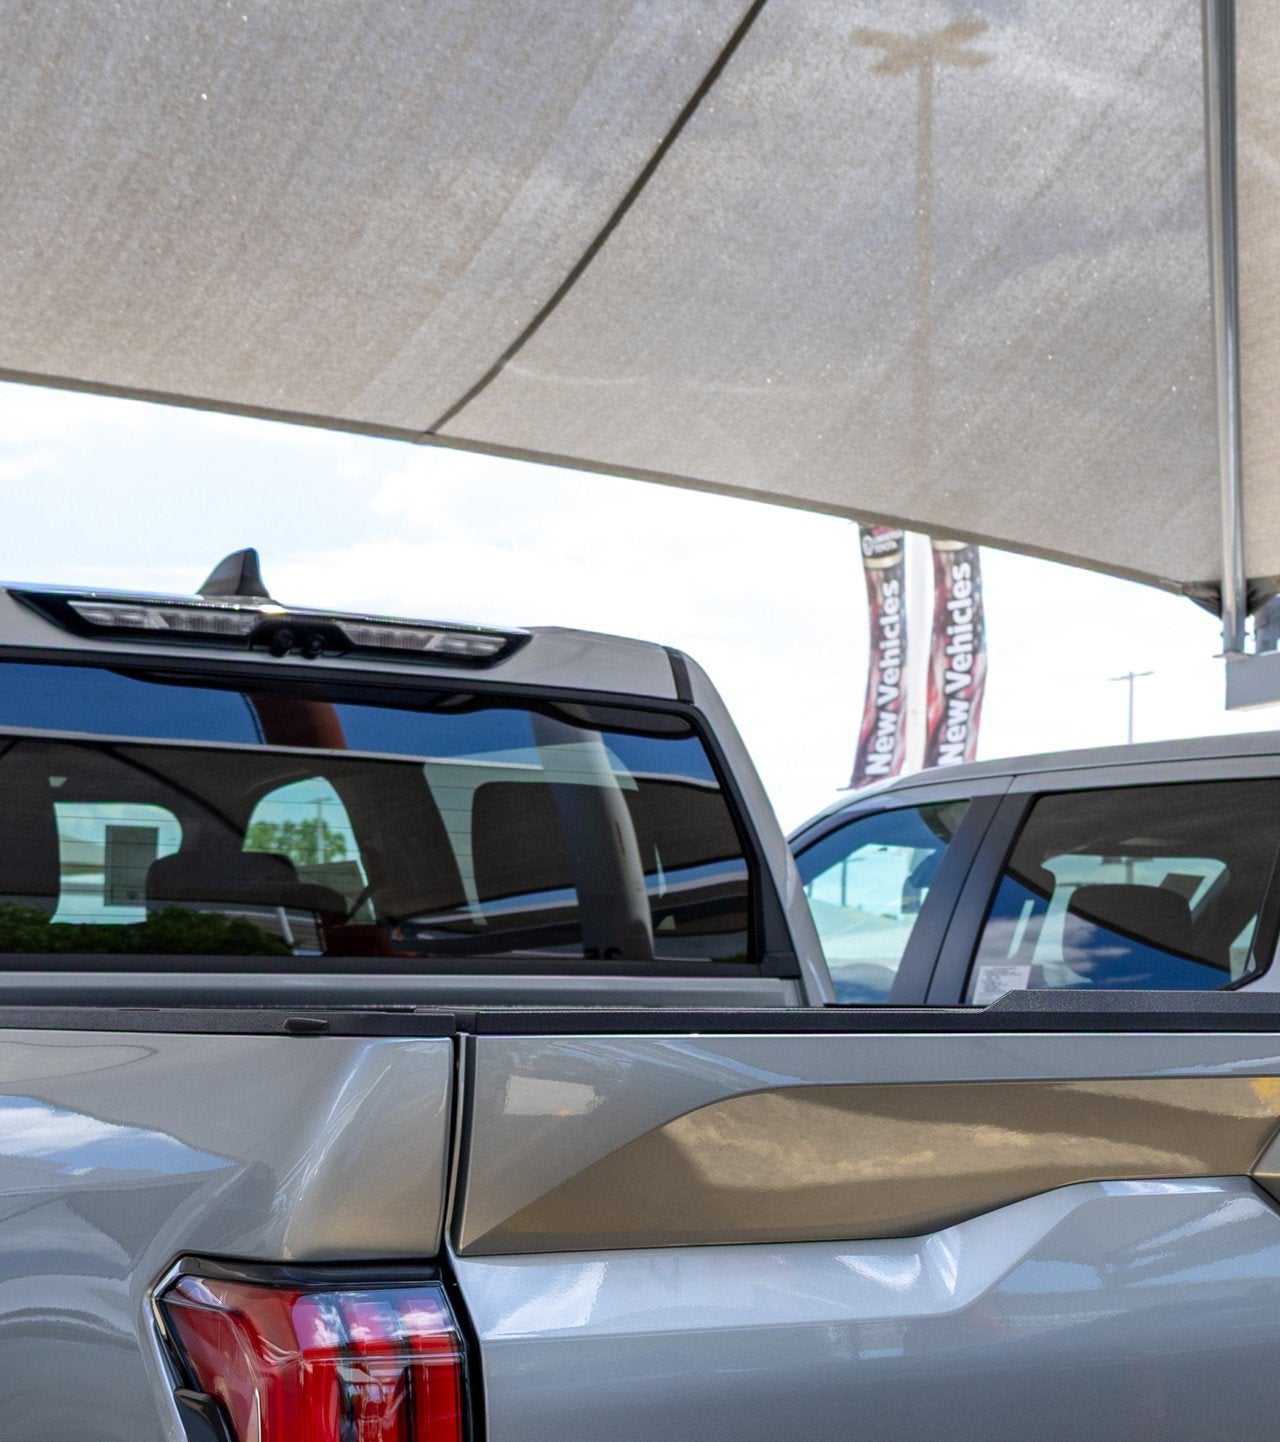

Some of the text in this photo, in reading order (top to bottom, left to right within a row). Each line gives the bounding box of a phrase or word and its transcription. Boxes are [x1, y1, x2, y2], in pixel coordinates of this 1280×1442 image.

[877, 578, 902, 709] Vehicles
[938, 562, 973, 767] New Vehicles
[866, 711, 898, 776] New
